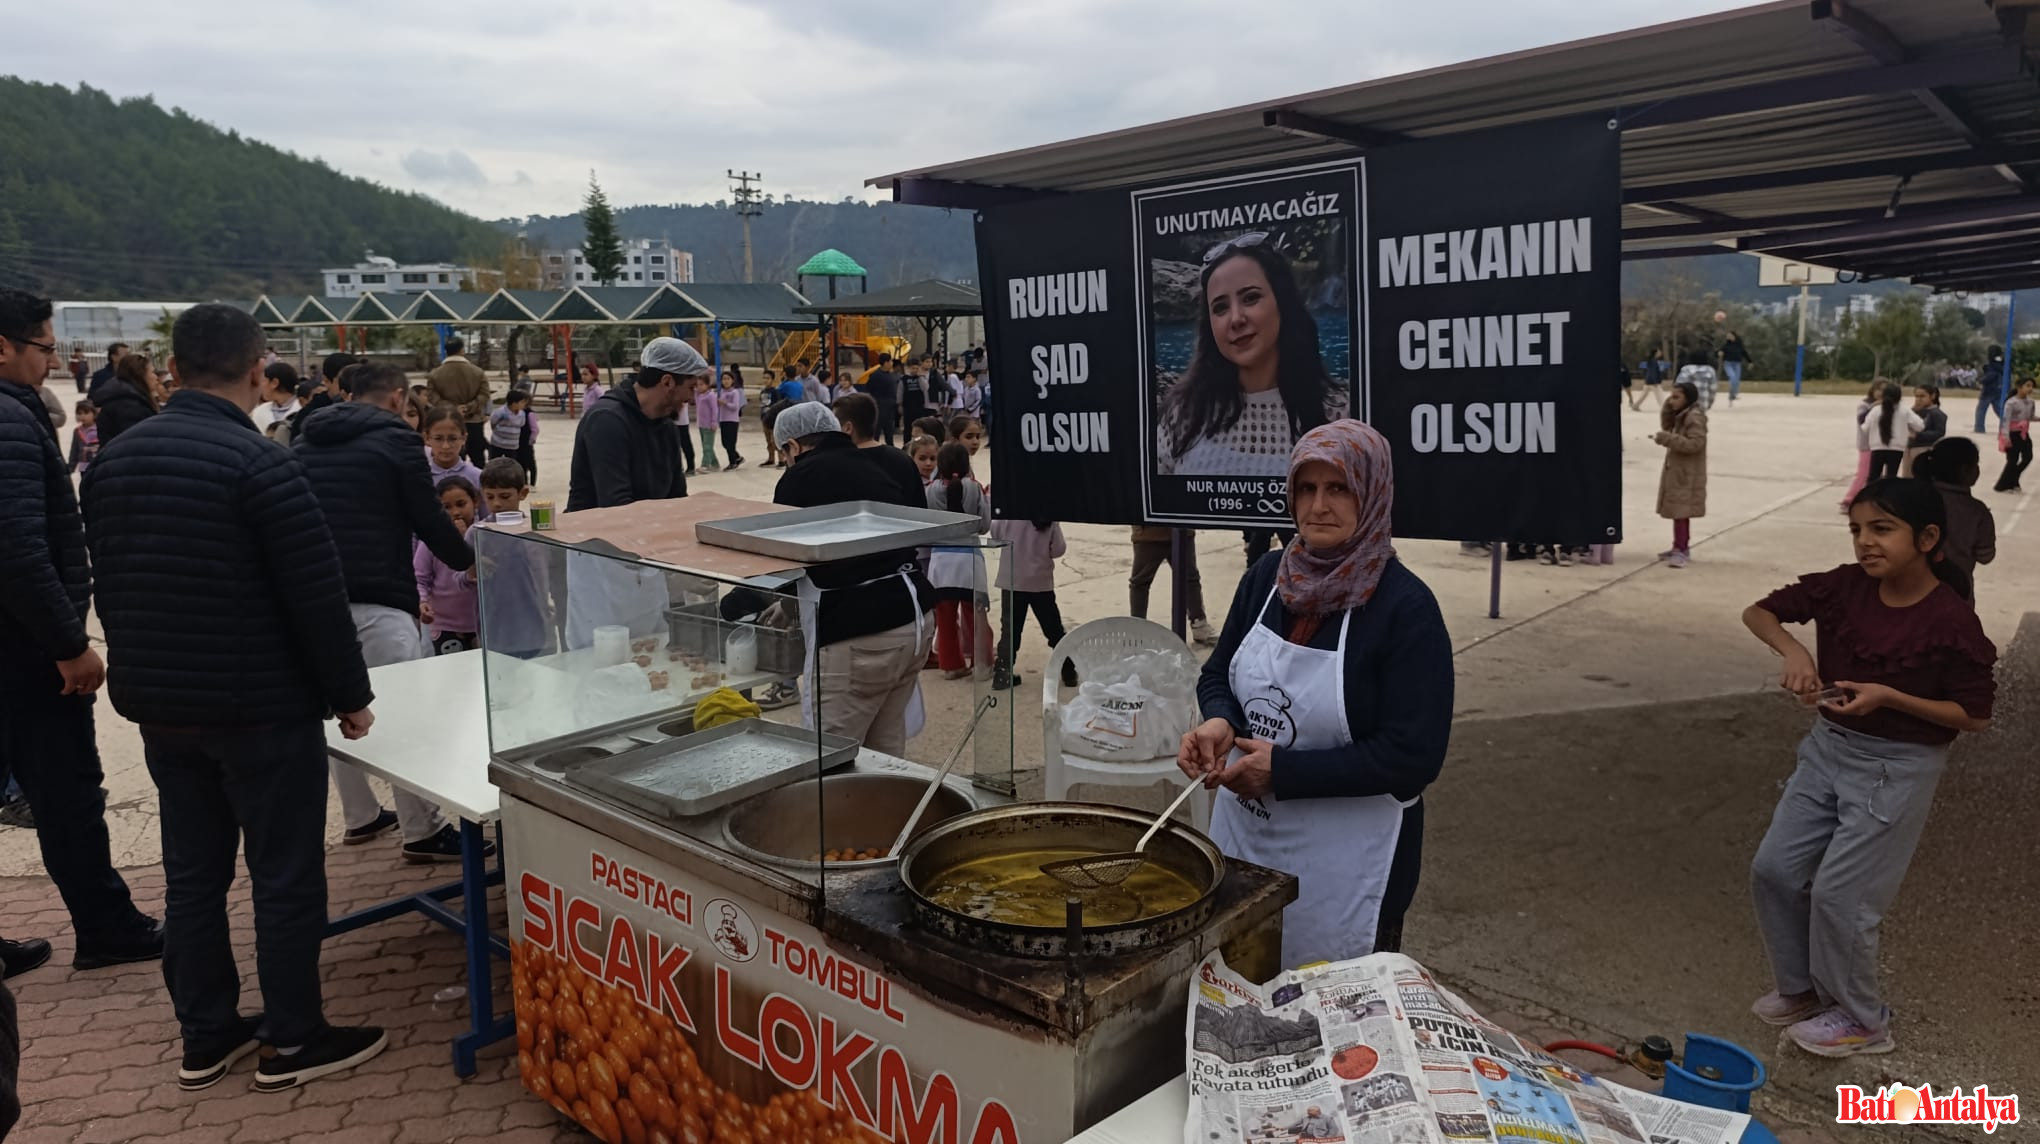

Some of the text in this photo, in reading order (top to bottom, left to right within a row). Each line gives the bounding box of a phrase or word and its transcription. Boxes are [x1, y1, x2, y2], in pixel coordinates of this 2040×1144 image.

[1155, 191, 1340, 237] UNUTMAYACAĞIZ
[1379, 217, 1592, 289] MEKANIN
[1009, 269, 1108, 320] RUHUN
[1400, 311, 1571, 370] CENNET
[1031, 342, 1090, 399] ŞAD
[1021, 411, 1111, 454] OLSUN
[1410, 401, 1557, 454] OLSUN
[1186, 479, 1288, 498] NUR MAVUŞ ÖZ
[1208, 497, 1243, 512] (1996
[1248, 710, 1286, 731] AKYOL
[1250, 722, 1278, 741] GIDA
[592, 852, 693, 925] PASTACI
[520, 871, 697, 1034] SICAK
[764, 928, 906, 1025] TOMBUL
[1192, 1057, 1224, 1080] Tek
[1257, 1065, 1329, 1091] tutundu
